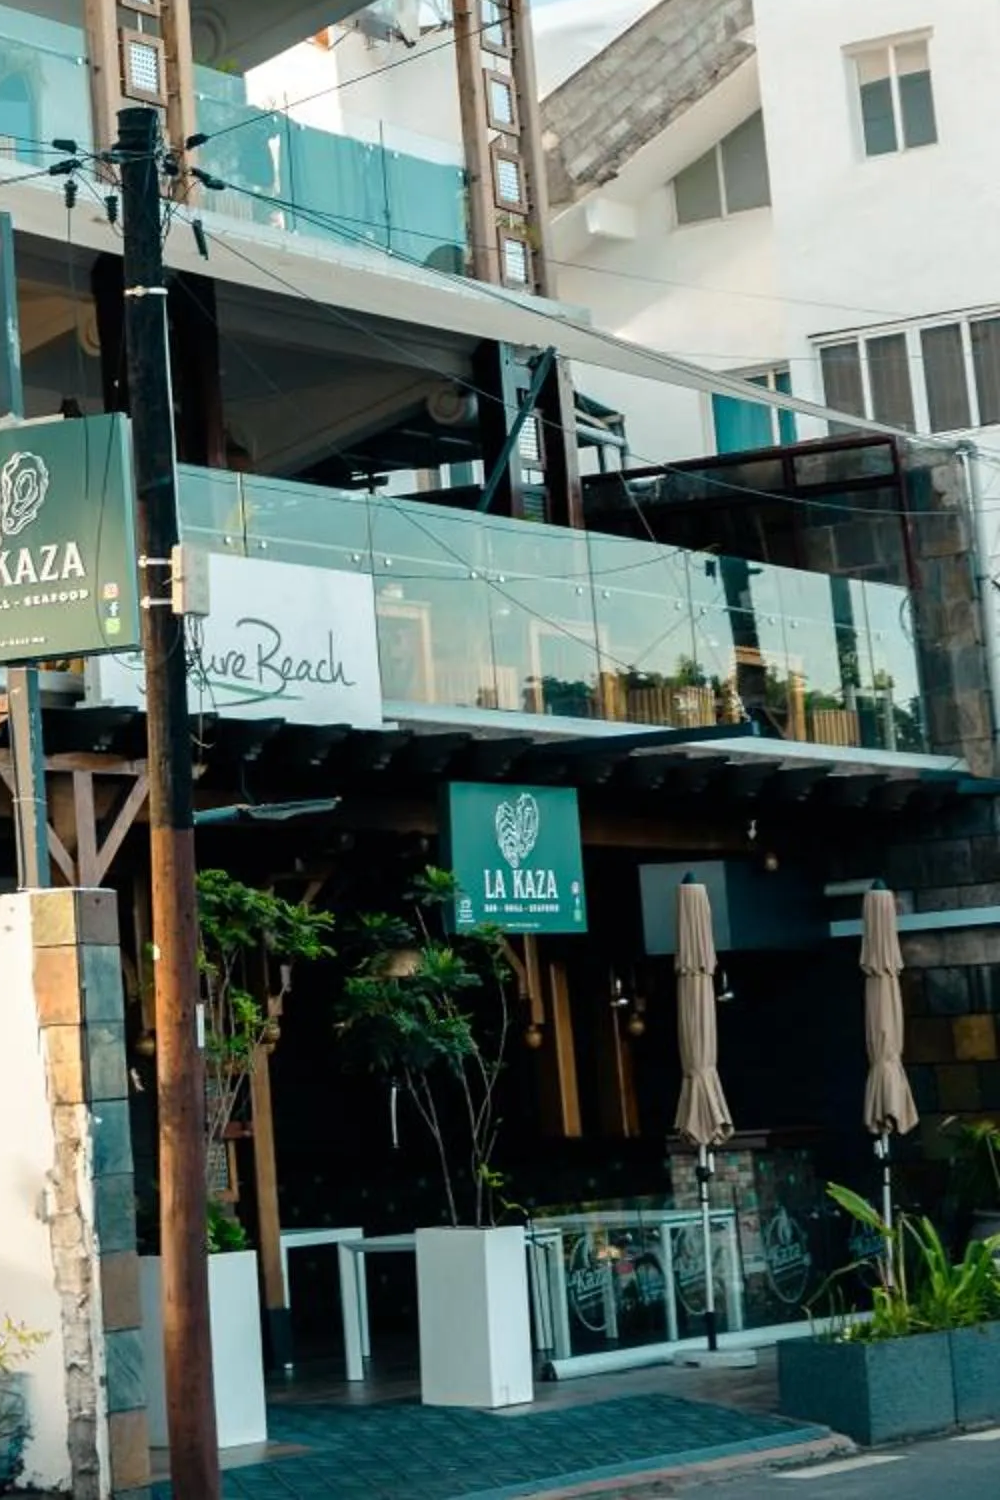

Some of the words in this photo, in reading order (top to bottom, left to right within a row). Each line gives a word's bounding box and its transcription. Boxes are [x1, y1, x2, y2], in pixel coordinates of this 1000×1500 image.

[23, 589, 88, 606] SEAFOOD
[232, 617, 356, 701] Beach
[484, 869, 506, 898] LA
[513, 869, 558, 898] KAZA
